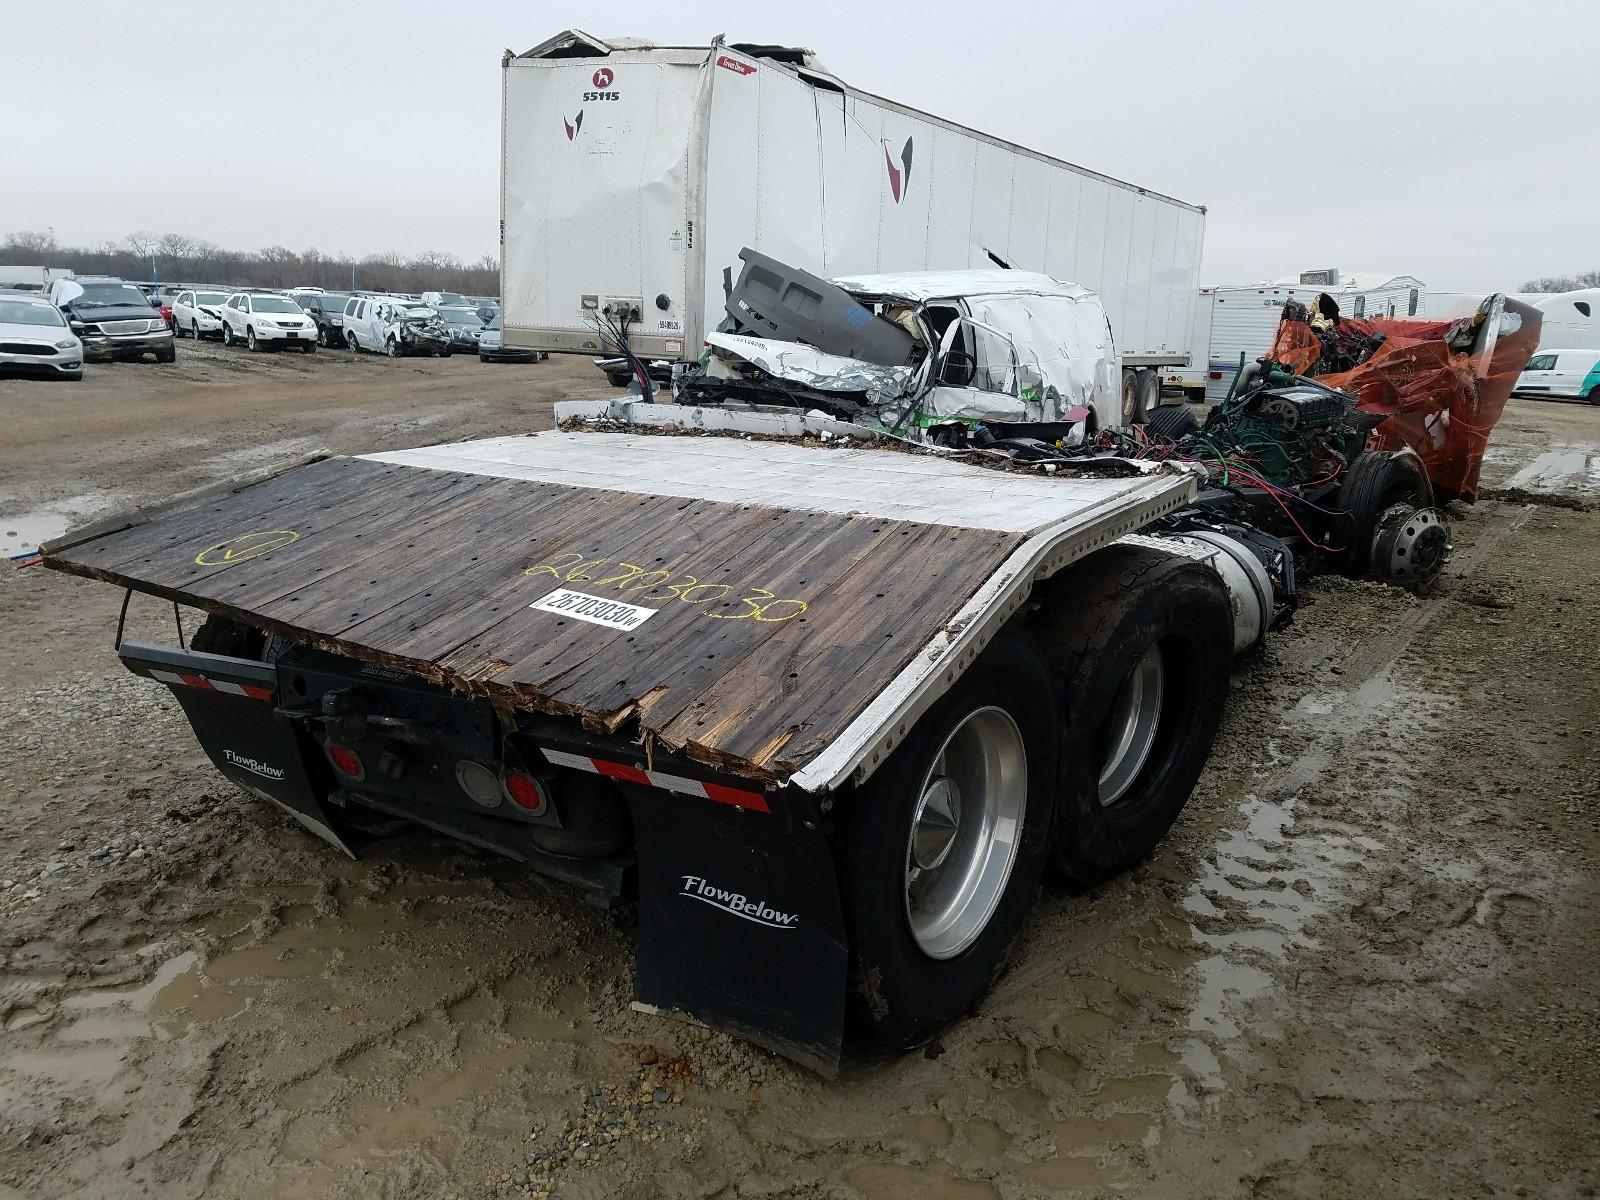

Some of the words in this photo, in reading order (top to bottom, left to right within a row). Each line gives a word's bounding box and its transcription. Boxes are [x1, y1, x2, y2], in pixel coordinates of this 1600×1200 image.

[582, 91, 620, 102] 55115
[222, 749, 285, 778] FlowBelow
[680, 875, 799, 926] FlowBelow
